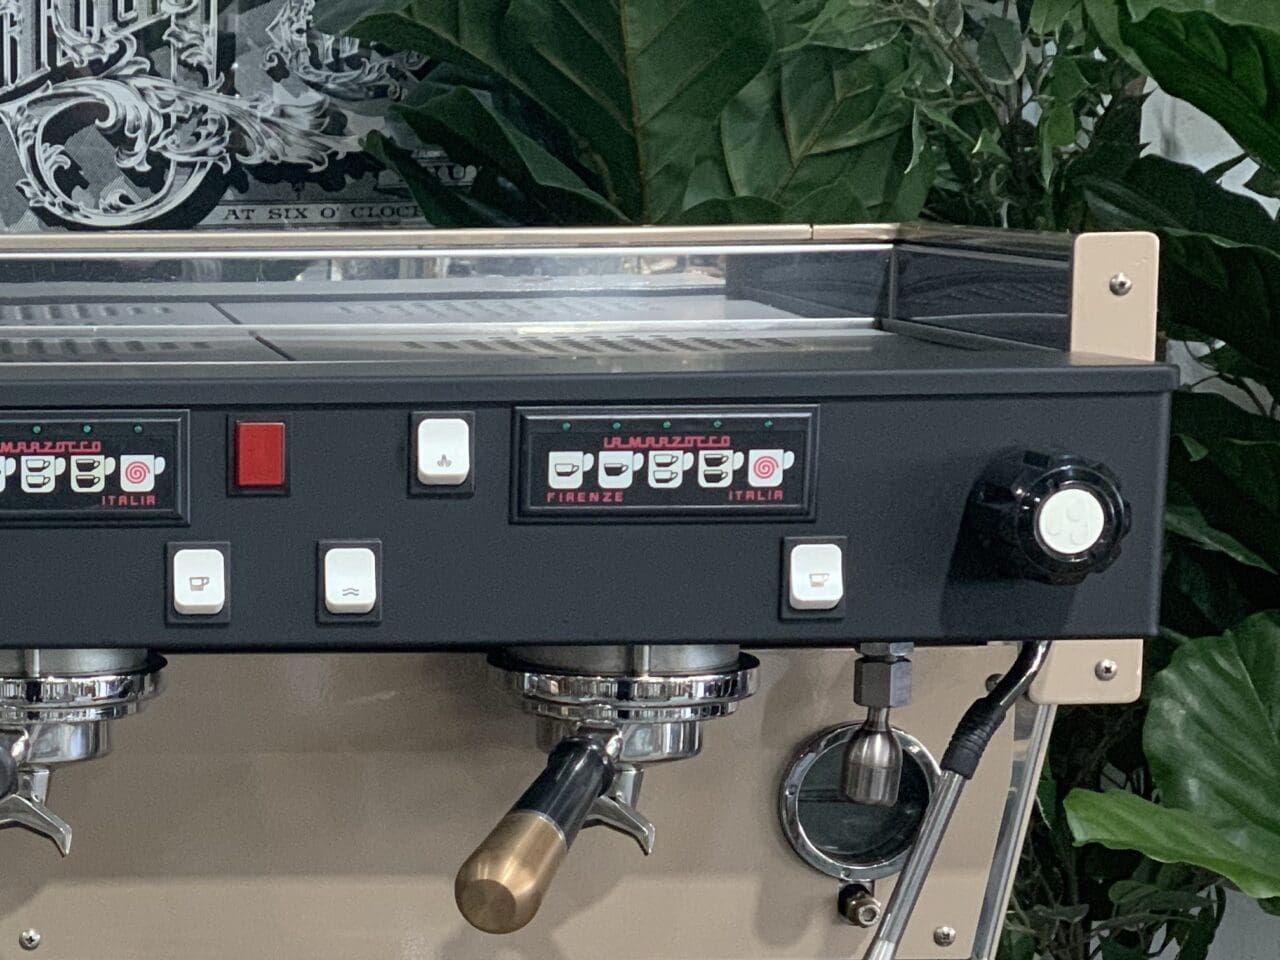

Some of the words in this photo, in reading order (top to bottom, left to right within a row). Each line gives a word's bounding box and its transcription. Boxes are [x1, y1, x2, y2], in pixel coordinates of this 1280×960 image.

[222, 208, 255, 220] AT
[269, 208, 308, 220] SIX
[102, 495, 156, 506] ITALIA
[547, 491, 624, 502] FIRENZE
[728, 490, 783, 501] ITALIA
